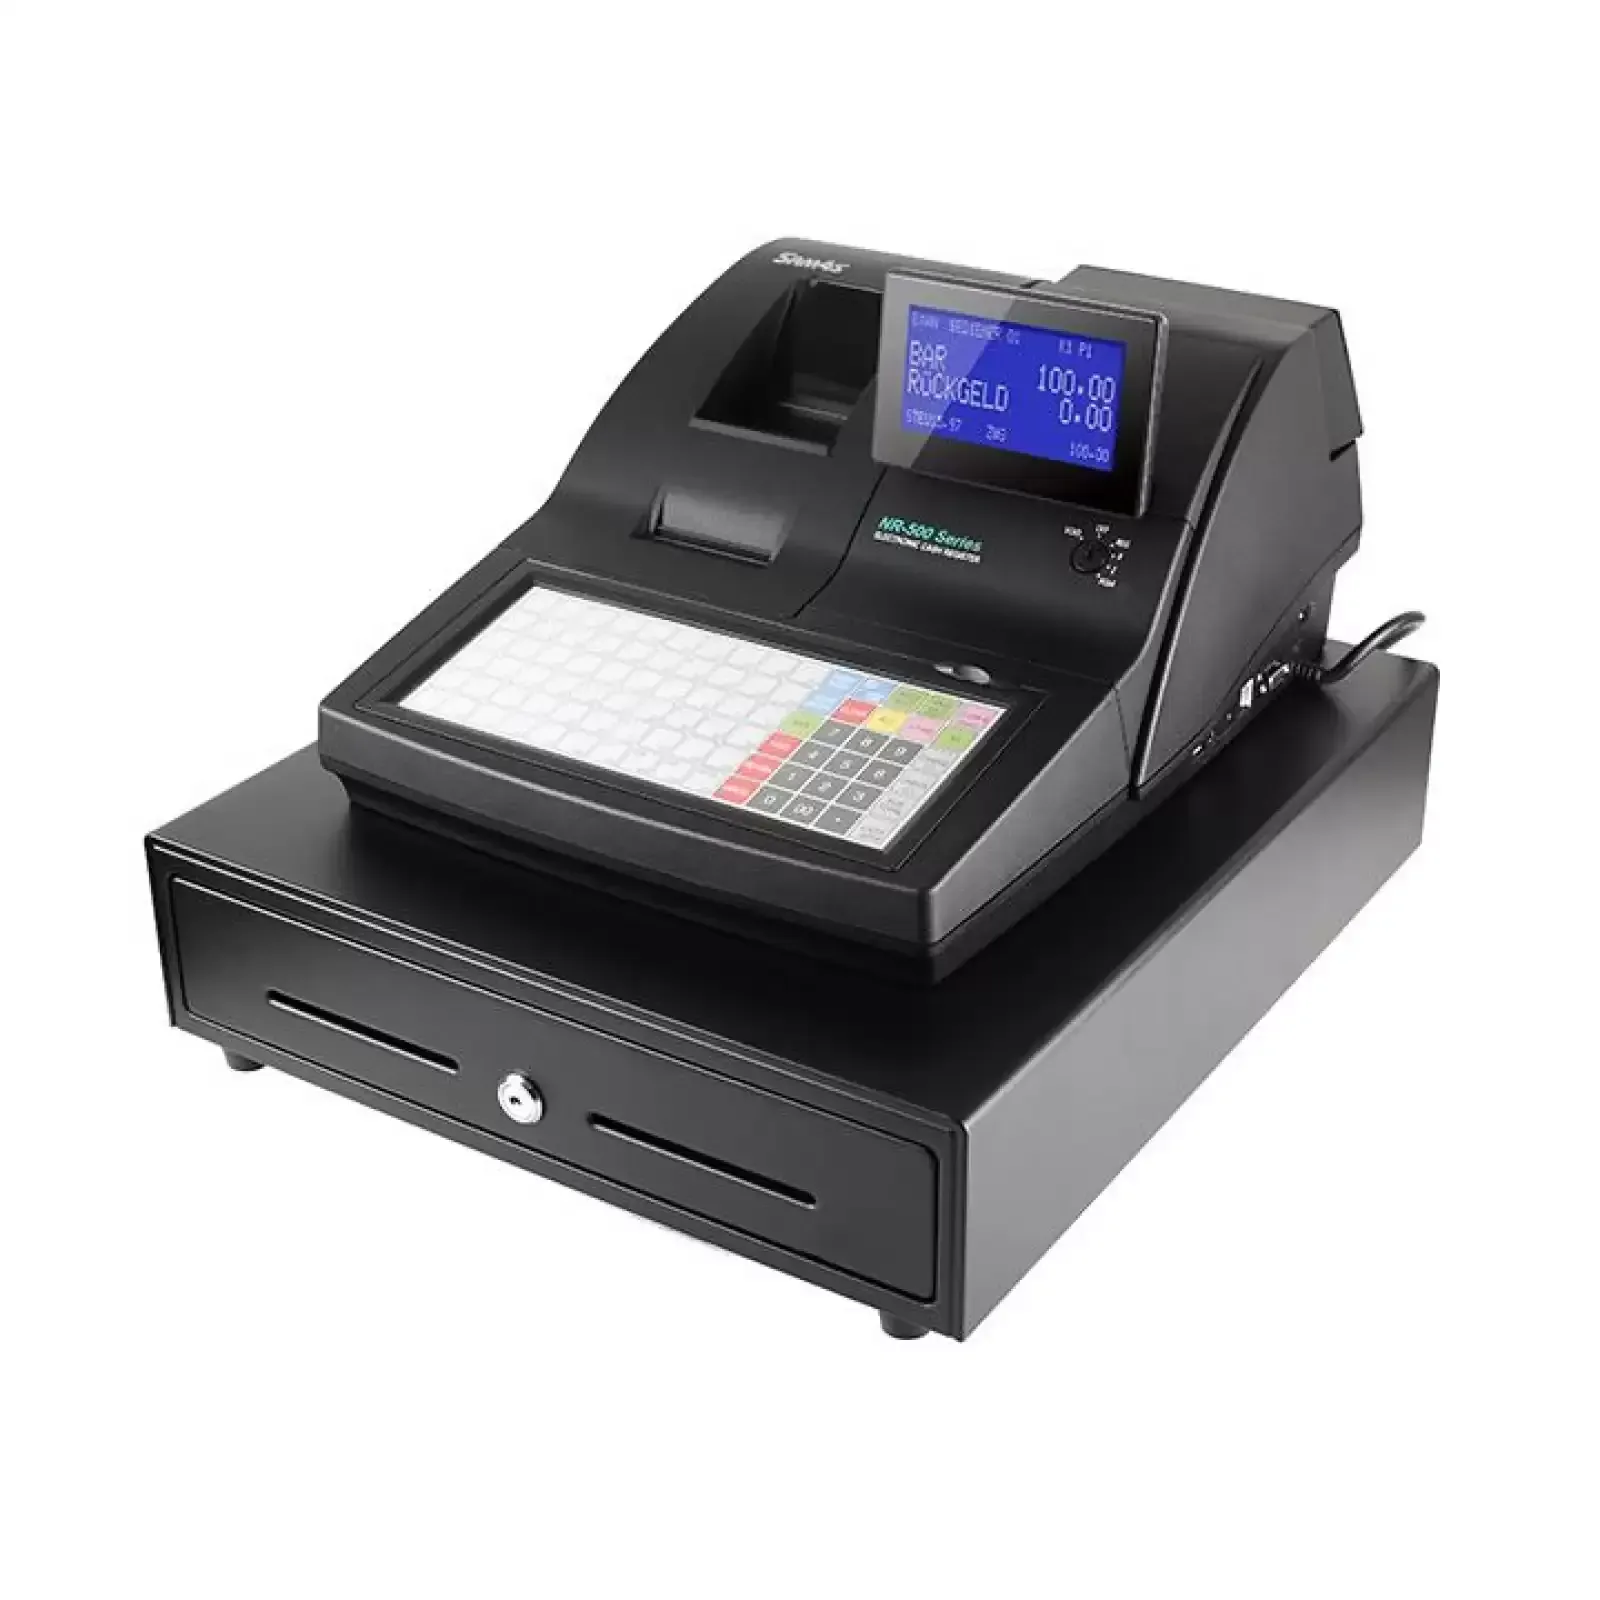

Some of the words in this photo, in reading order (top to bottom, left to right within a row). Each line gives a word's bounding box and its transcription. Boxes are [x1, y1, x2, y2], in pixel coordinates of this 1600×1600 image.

[909, 339, 949, 373] BAR
[1036, 363, 1117, 404] 100.00
[1058, 397, 1113, 432] 0.00
[876, 514, 935, 540] NR-500
[934, 528, 983, 552] Series
